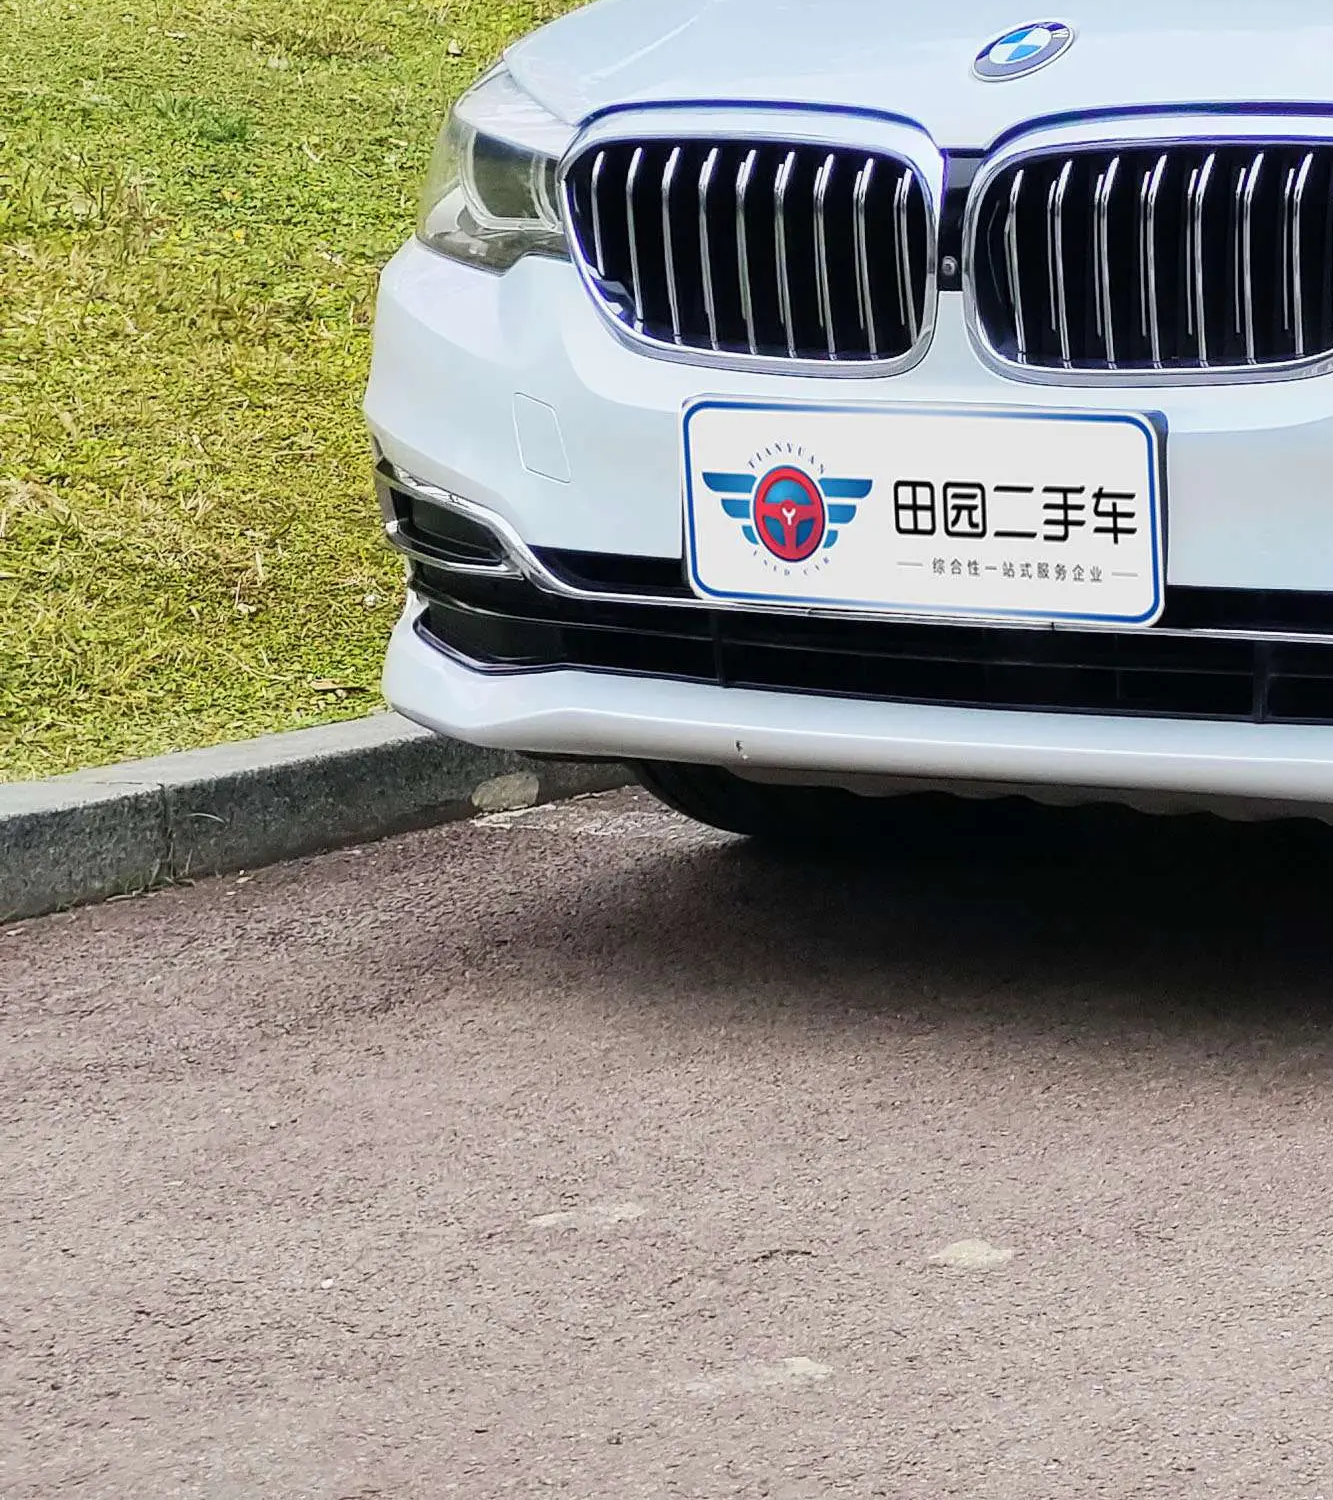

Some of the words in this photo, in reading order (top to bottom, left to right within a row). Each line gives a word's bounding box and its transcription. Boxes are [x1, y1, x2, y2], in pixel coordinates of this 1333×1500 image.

[894, 480, 1137, 544] 田园二手车
[932, 557, 1102, 582] 综合性一站式服务企业
